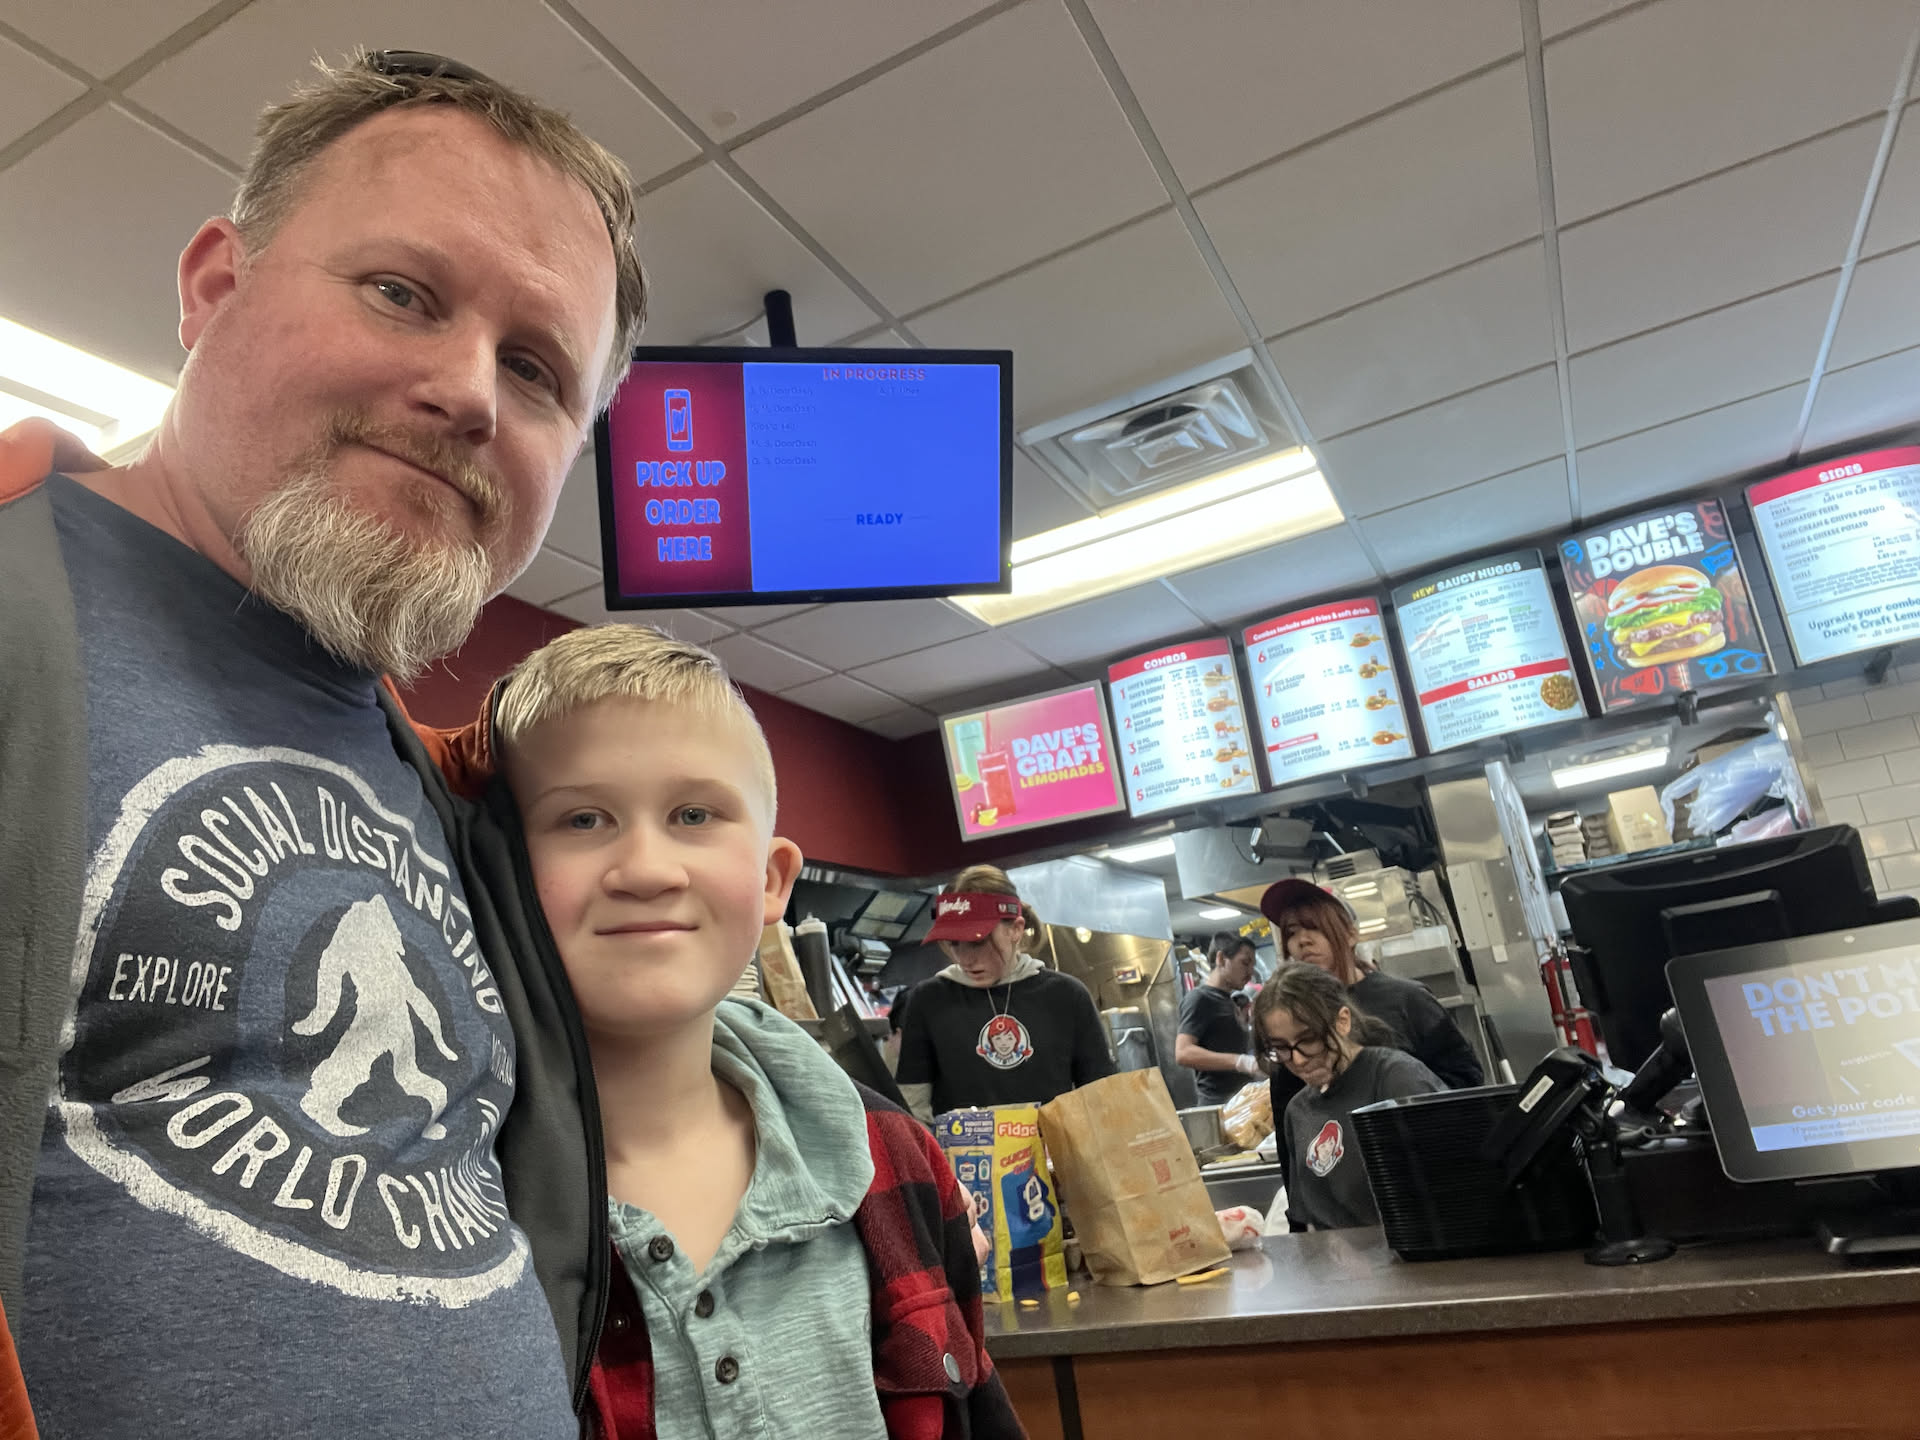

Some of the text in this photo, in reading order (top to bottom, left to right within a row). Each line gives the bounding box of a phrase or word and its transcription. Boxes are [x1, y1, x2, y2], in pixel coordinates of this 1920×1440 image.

[823, 368, 926, 381] IN PROGRESS
[636, 461, 726, 487] PICK UP
[1818, 463, 1863, 483] SIDES
[645, 499, 721, 525] ORDER
[855, 512, 904, 526] READY
[1585, 511, 1698, 558] DAVE'S
[657, 536, 713, 561] HERE
[1591, 532, 1705, 579] DOUBLE
[1412, 584, 1436, 600] NEW
[1436, 571, 1477, 592] SAUCY
[1808, 610, 1856, 631] Upgrade
[1856, 605, 1882, 620] your
[1823, 622, 1858, 640] Dave's
[1860, 614, 1892, 630] Craft
[1143, 652, 1188, 671] COMBOS
[1257, 650, 1267, 664] 6
[1264, 683, 1273, 698] 7
[1467, 670, 1516, 690] SALADS
[1120, 688, 1126, 700] 1
[1124, 717, 1132, 729] 2
[1271, 716, 1280, 729] 8
[1011, 723, 1099, 758] DAVE'S
[1128, 742, 1136, 755] 3
[1016, 742, 1101, 777] CRAFT
[1132, 765, 1140, 776] 4
[1019, 762, 1105, 789] LEMONADES
[1136, 788, 1144, 801] 5
[161, 781, 315, 932] SOCIAL
[318, 786, 504, 1015] DISTANCING
[109, 953, 232, 1012] EXPLORE
[1742, 966, 1871, 1011] DON'T
[1752, 1001, 1836, 1037] THE
[1792, 1104, 1825, 1119] Get
[1827, 1101, 1868, 1118] your
[951, 1120, 963, 1135] 6
[111, 1055, 368, 1230] WORLD
